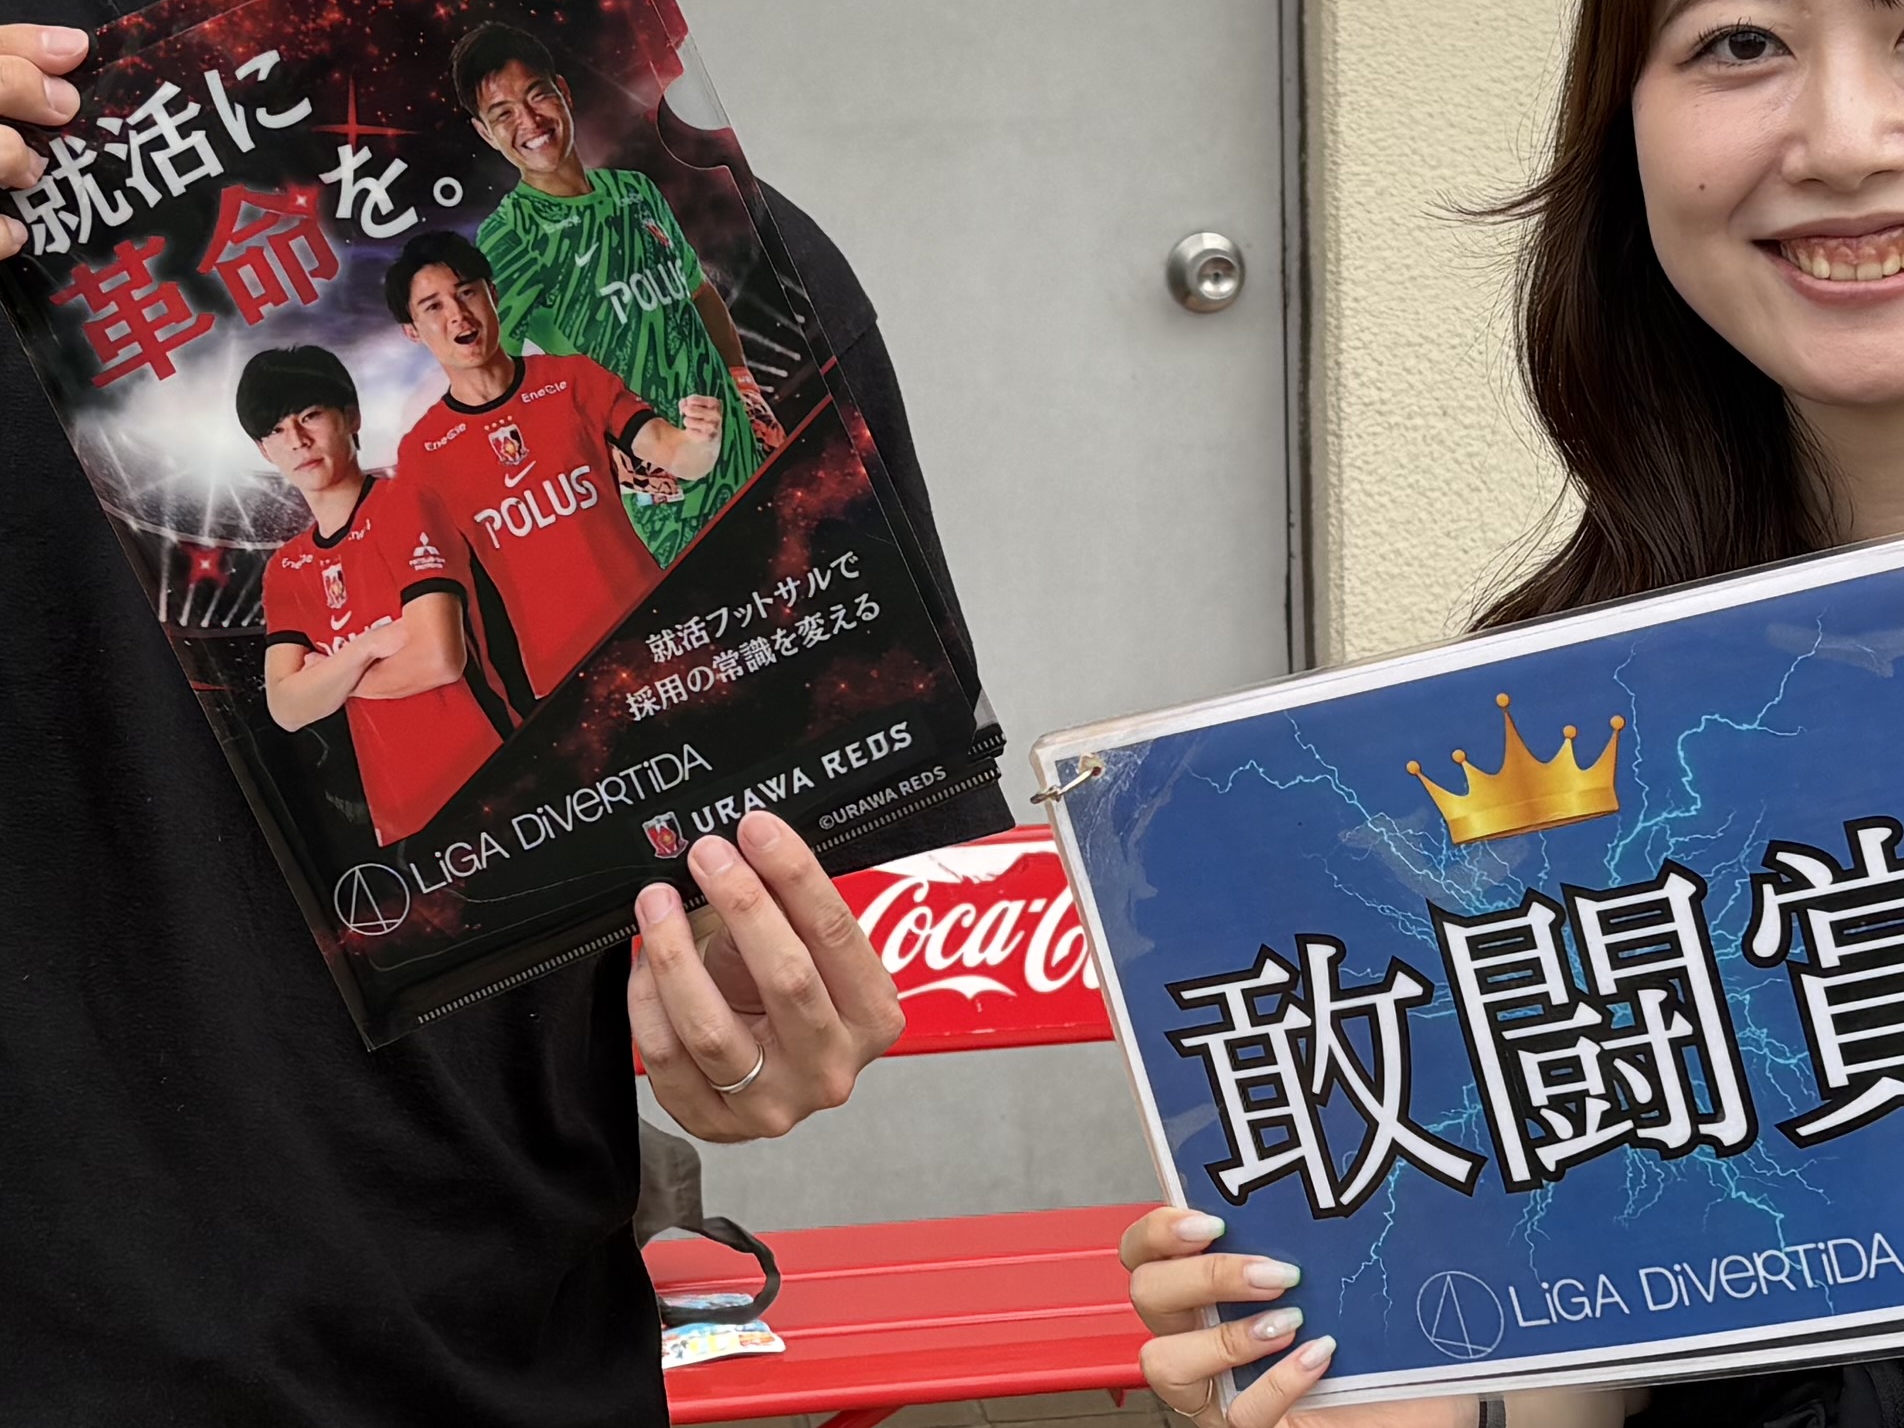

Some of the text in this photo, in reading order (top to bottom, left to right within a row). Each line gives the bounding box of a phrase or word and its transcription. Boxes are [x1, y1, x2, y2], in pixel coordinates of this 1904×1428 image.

[10, 49, 313, 256] 就活に
[474, 464, 599, 549] POLUS
[625, 592, 882, 722] 採用の常識を変える
[645, 550, 861, 664] 就活フットサルで
[690, 720, 915, 835] URAWA REDS
[897, 765, 949, 800] REDS
[857, 875, 1101, 994] Coca-C
